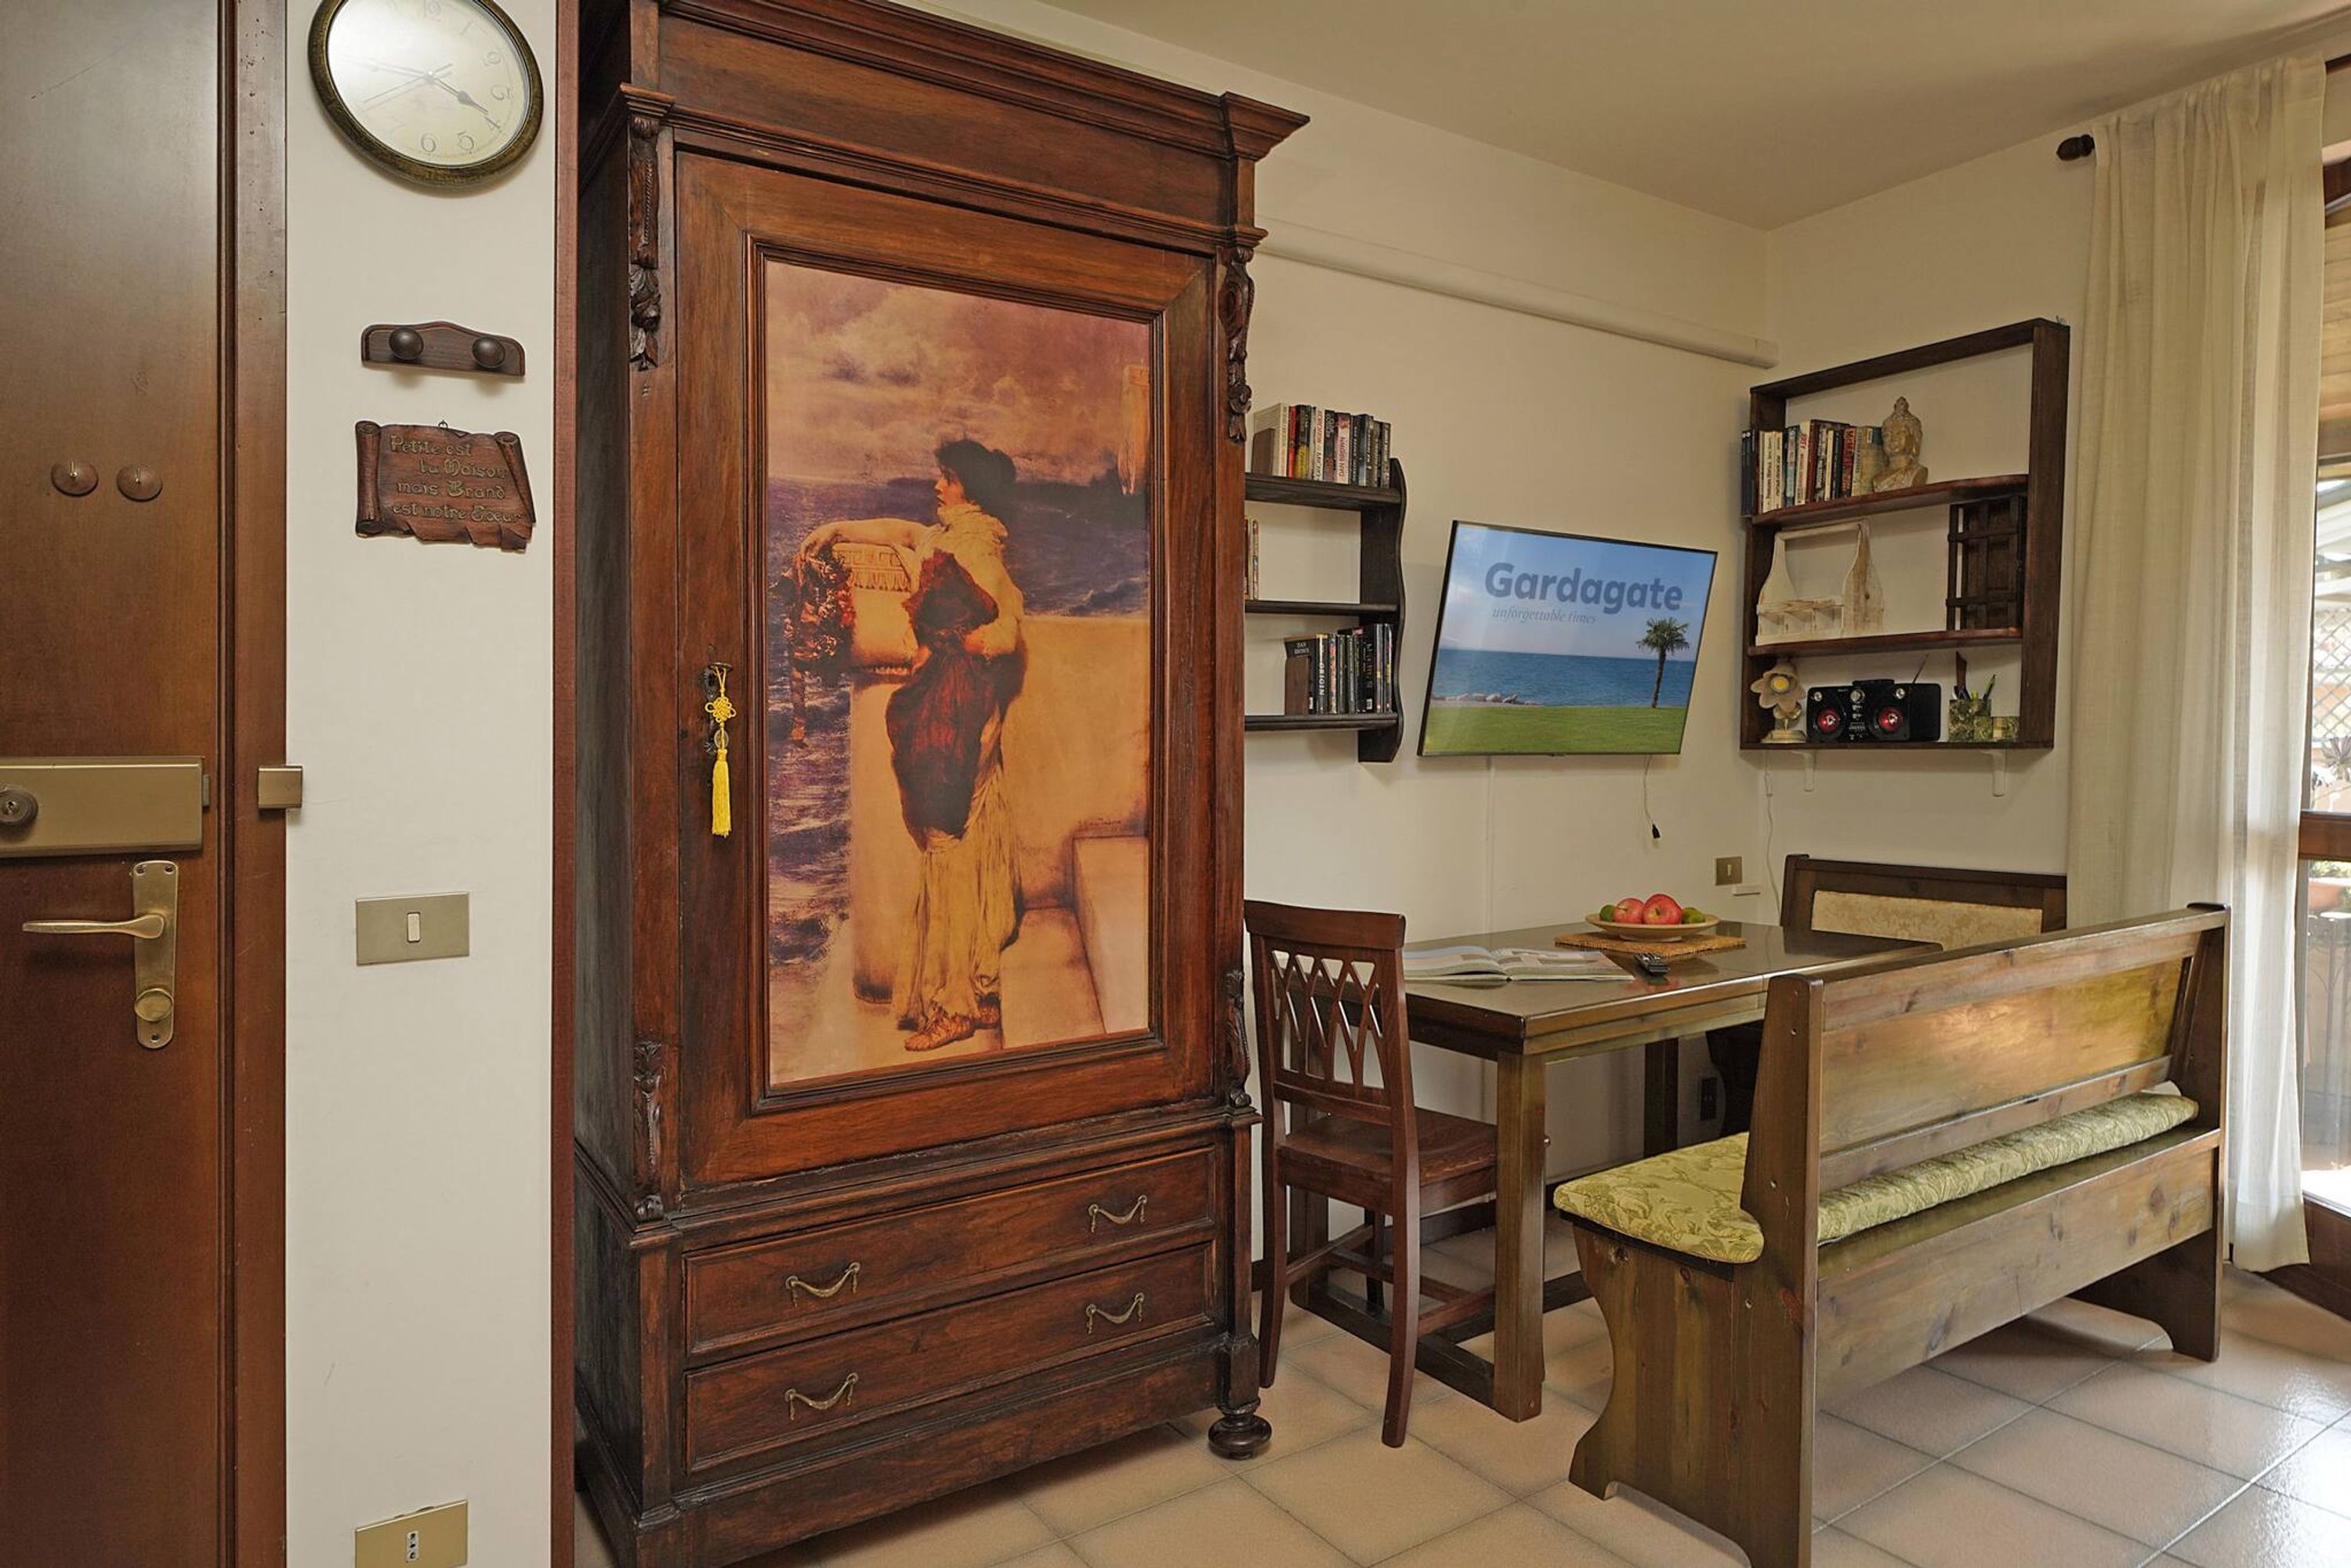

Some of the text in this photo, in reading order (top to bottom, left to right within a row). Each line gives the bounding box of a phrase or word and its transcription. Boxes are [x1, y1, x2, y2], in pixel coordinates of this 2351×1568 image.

[421, 132, 437, 156] 6
[458, 131, 475, 154] 5
[390, 435, 472, 456] Petite est
[444, 458, 506, 479] Maison
[397, 480, 506, 499] mais Grand
[393, 502, 417, 516] est
[423, 505, 468, 520] notre
[1485, 562, 1683, 614] Gardagate
[1492, 606, 1596, 624] unforgettable times
